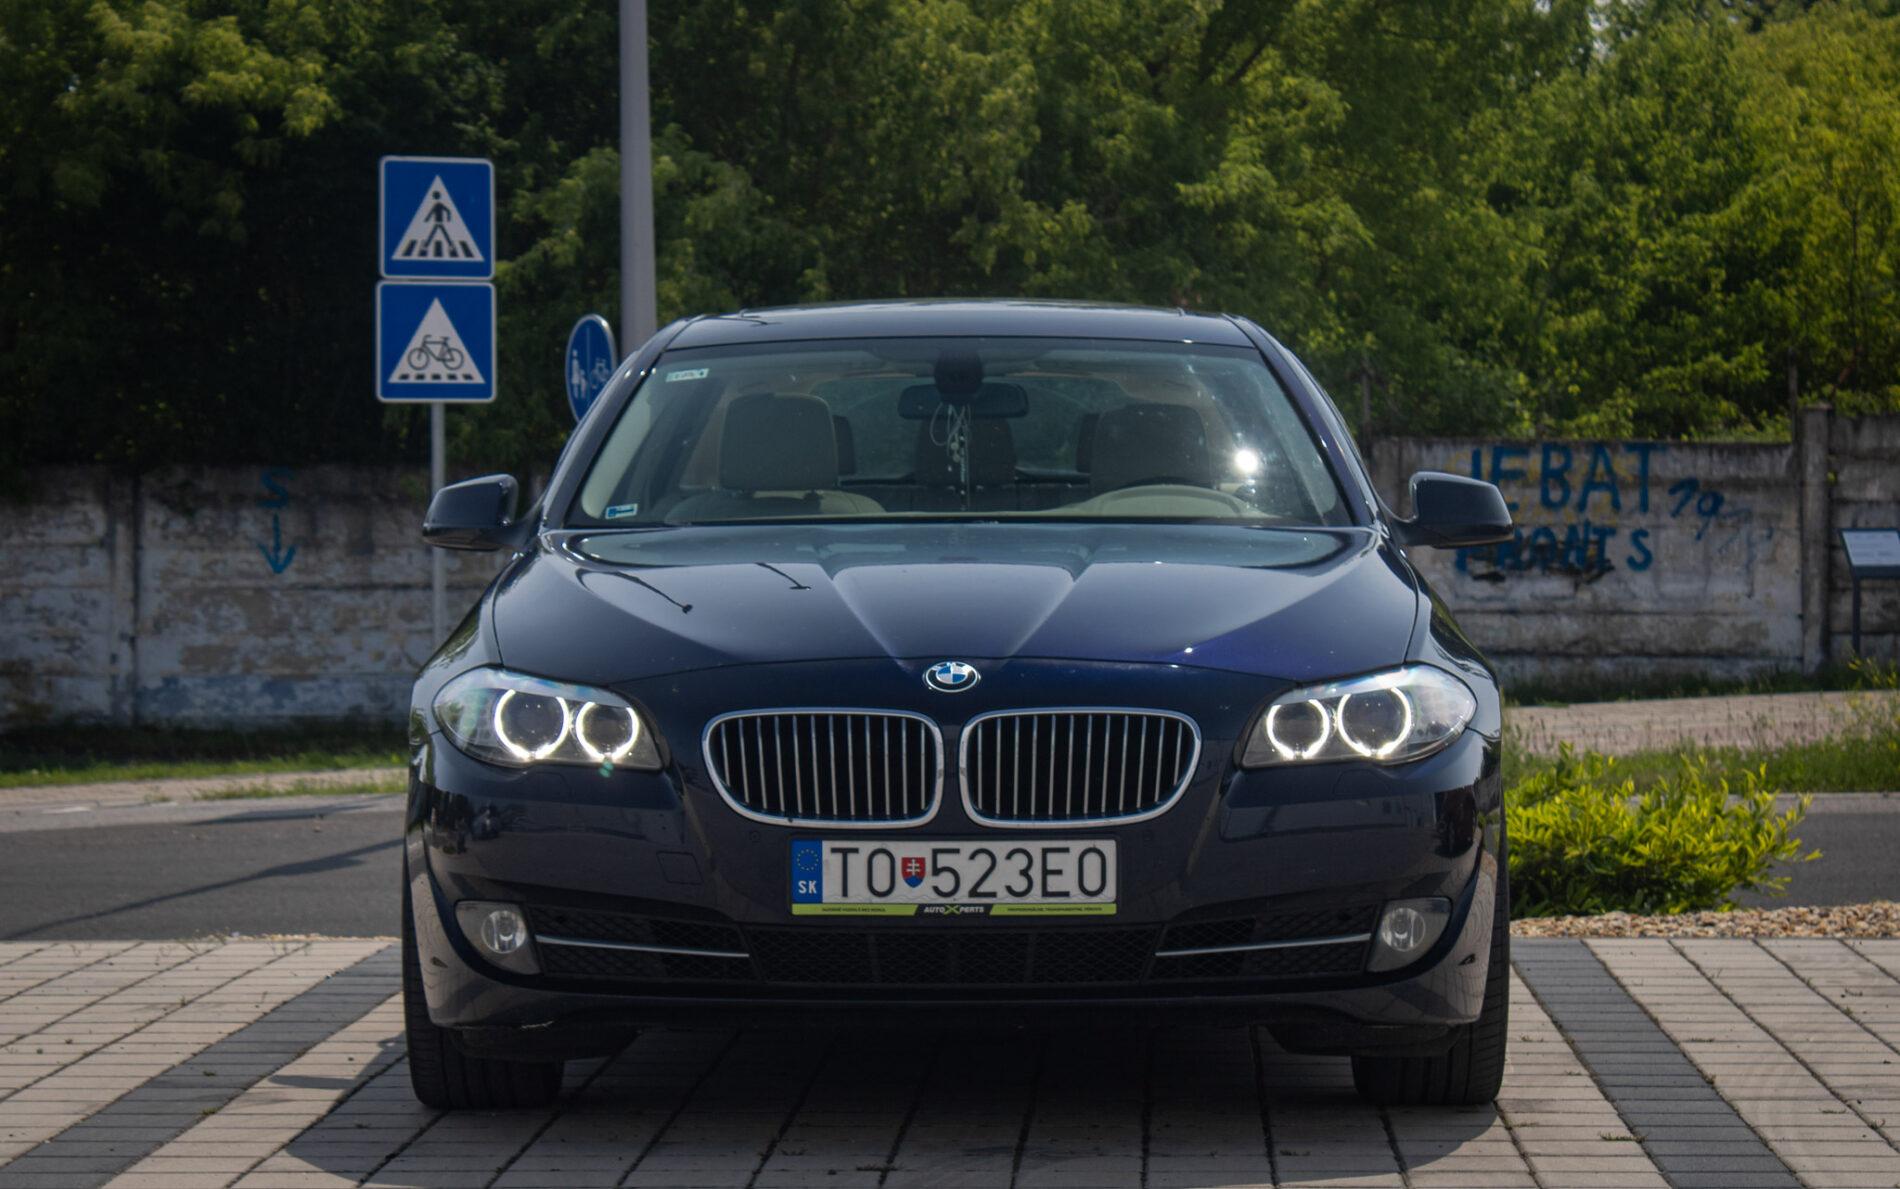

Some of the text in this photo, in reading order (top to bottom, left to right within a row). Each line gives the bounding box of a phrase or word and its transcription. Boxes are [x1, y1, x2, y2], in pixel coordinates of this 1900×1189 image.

[797, 880, 818, 894] SK
[830, 847, 1107, 898] TO 523EO
